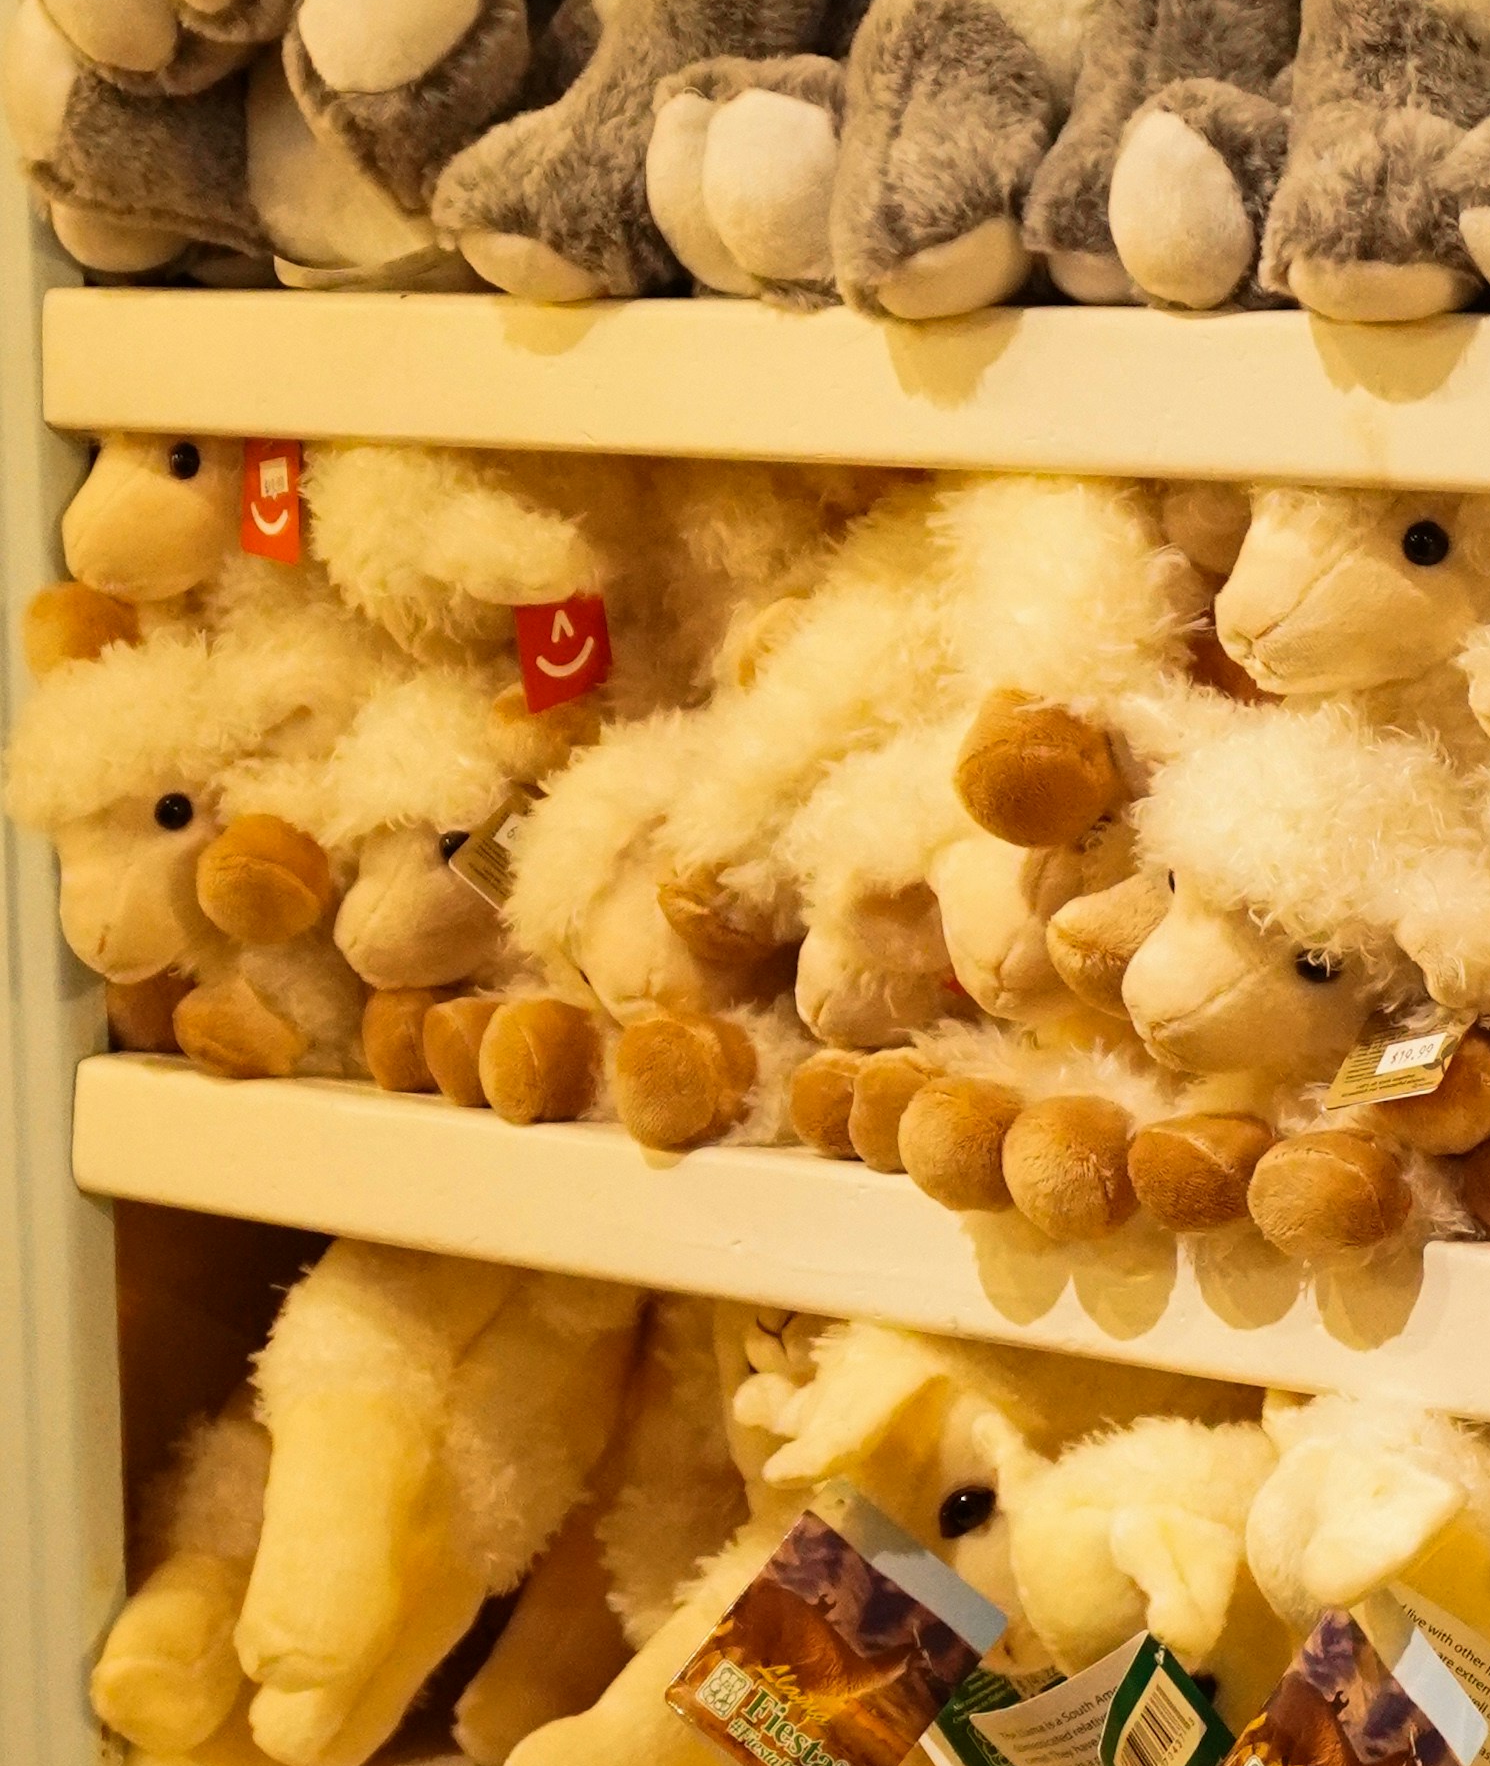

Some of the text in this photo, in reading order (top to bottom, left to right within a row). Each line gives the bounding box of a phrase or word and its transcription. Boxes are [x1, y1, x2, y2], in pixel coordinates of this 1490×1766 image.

[1404, 1607, 1428, 1629] live
[1426, 1622, 1455, 1647] with
[1452, 1642, 1486, 1670] other
